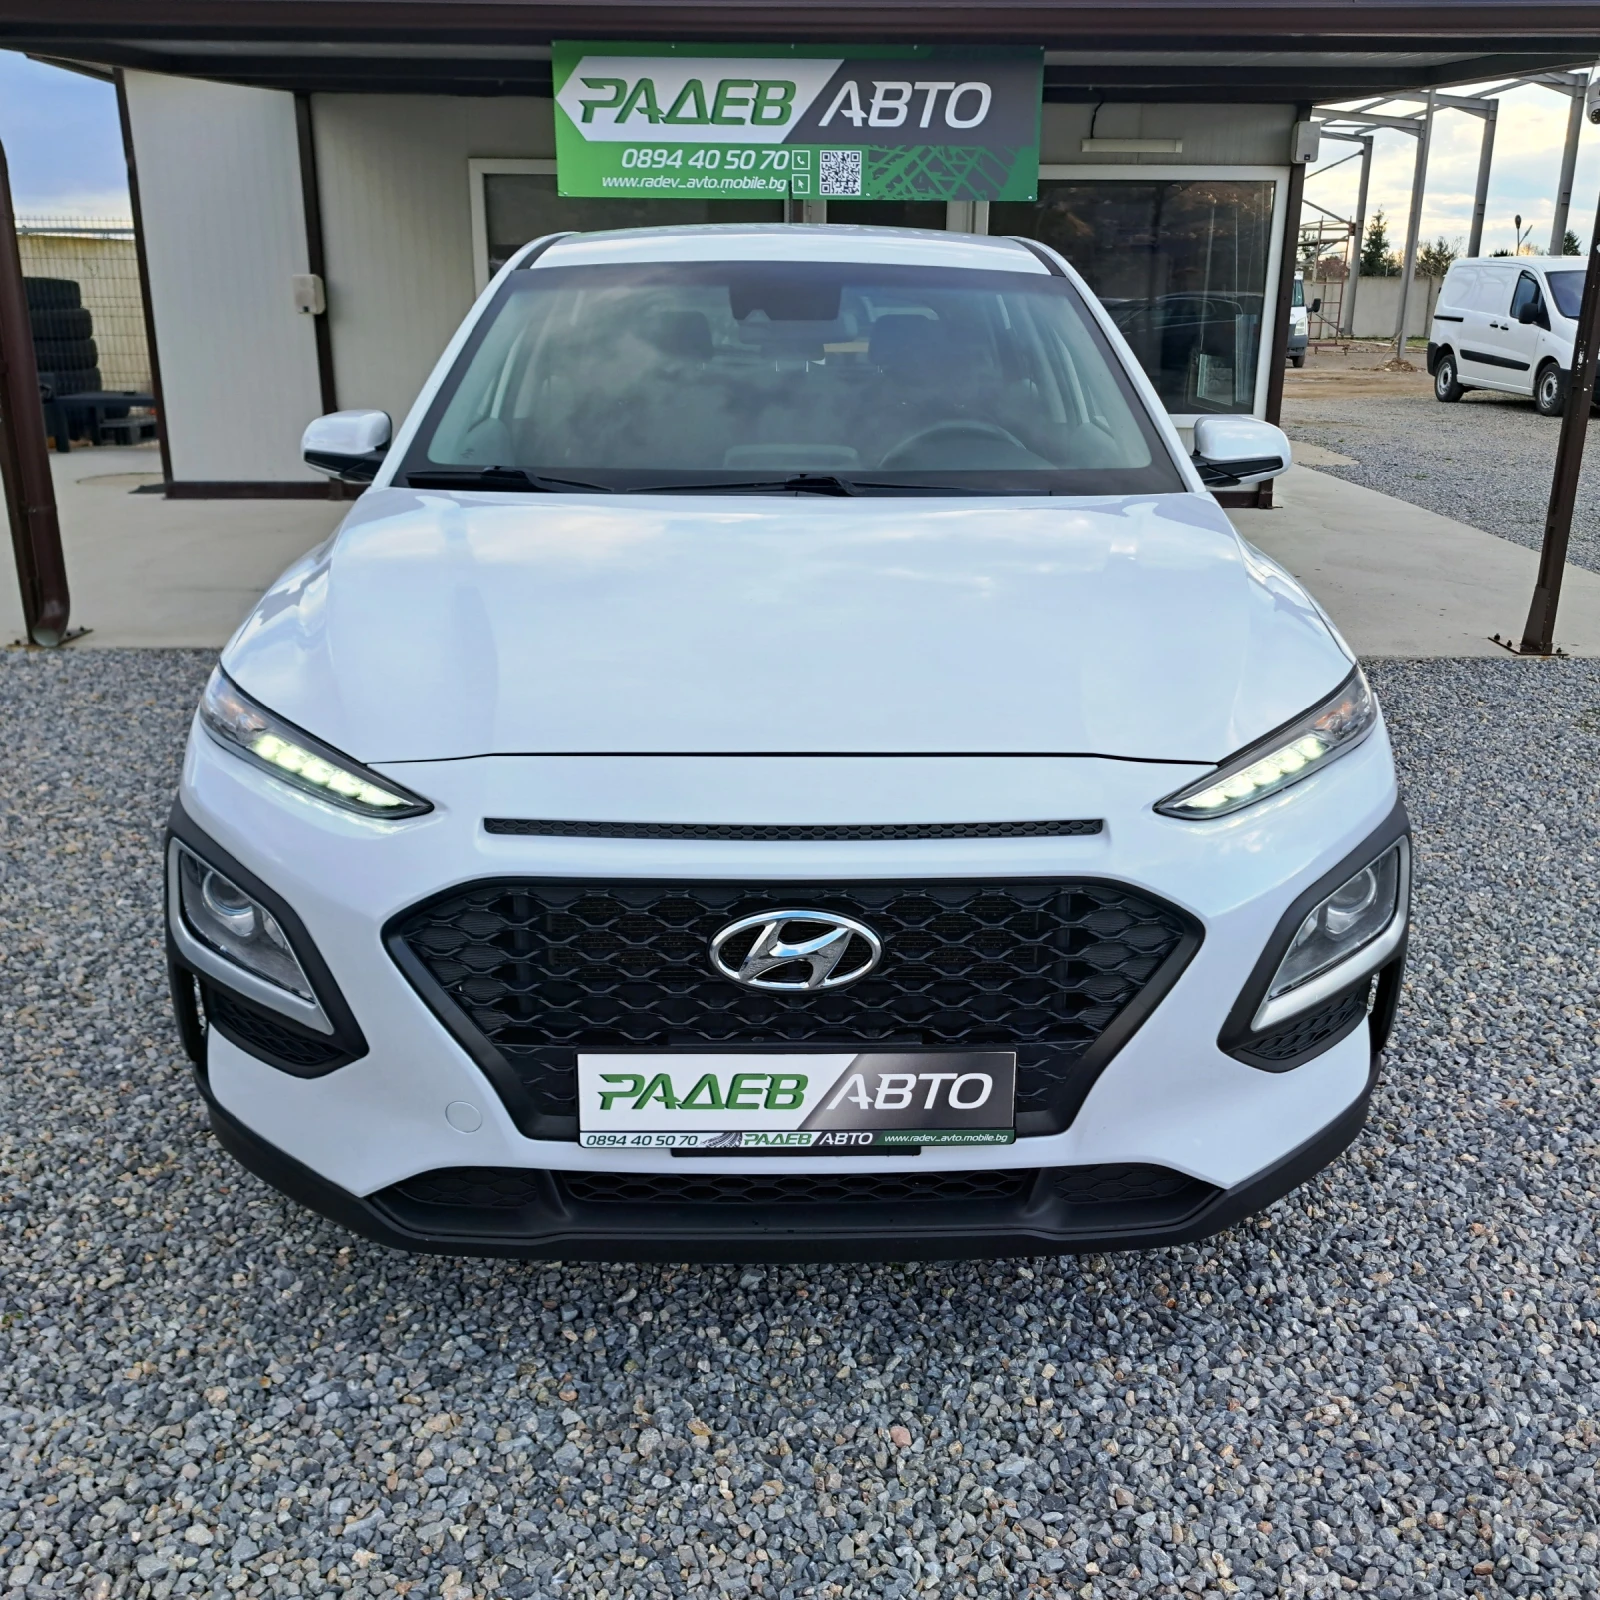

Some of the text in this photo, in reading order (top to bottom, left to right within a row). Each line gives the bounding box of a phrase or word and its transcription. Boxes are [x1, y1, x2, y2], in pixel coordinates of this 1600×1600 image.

[578, 77, 992, 129] РАДЕВ АВТО
[621, 148, 790, 170] 0894 40 50 70
[602, 175, 787, 192] www.radev_avto.mobile.bg
[597, 1072, 993, 1110] РАДЕВ АВТО
[586, 1134, 699, 1146] 0894 40 50 70
[743, 1132, 873, 1146] РАДЕВ АВТО
[884, 1132, 1008, 1143] www.radev_avto.mobile.bg
